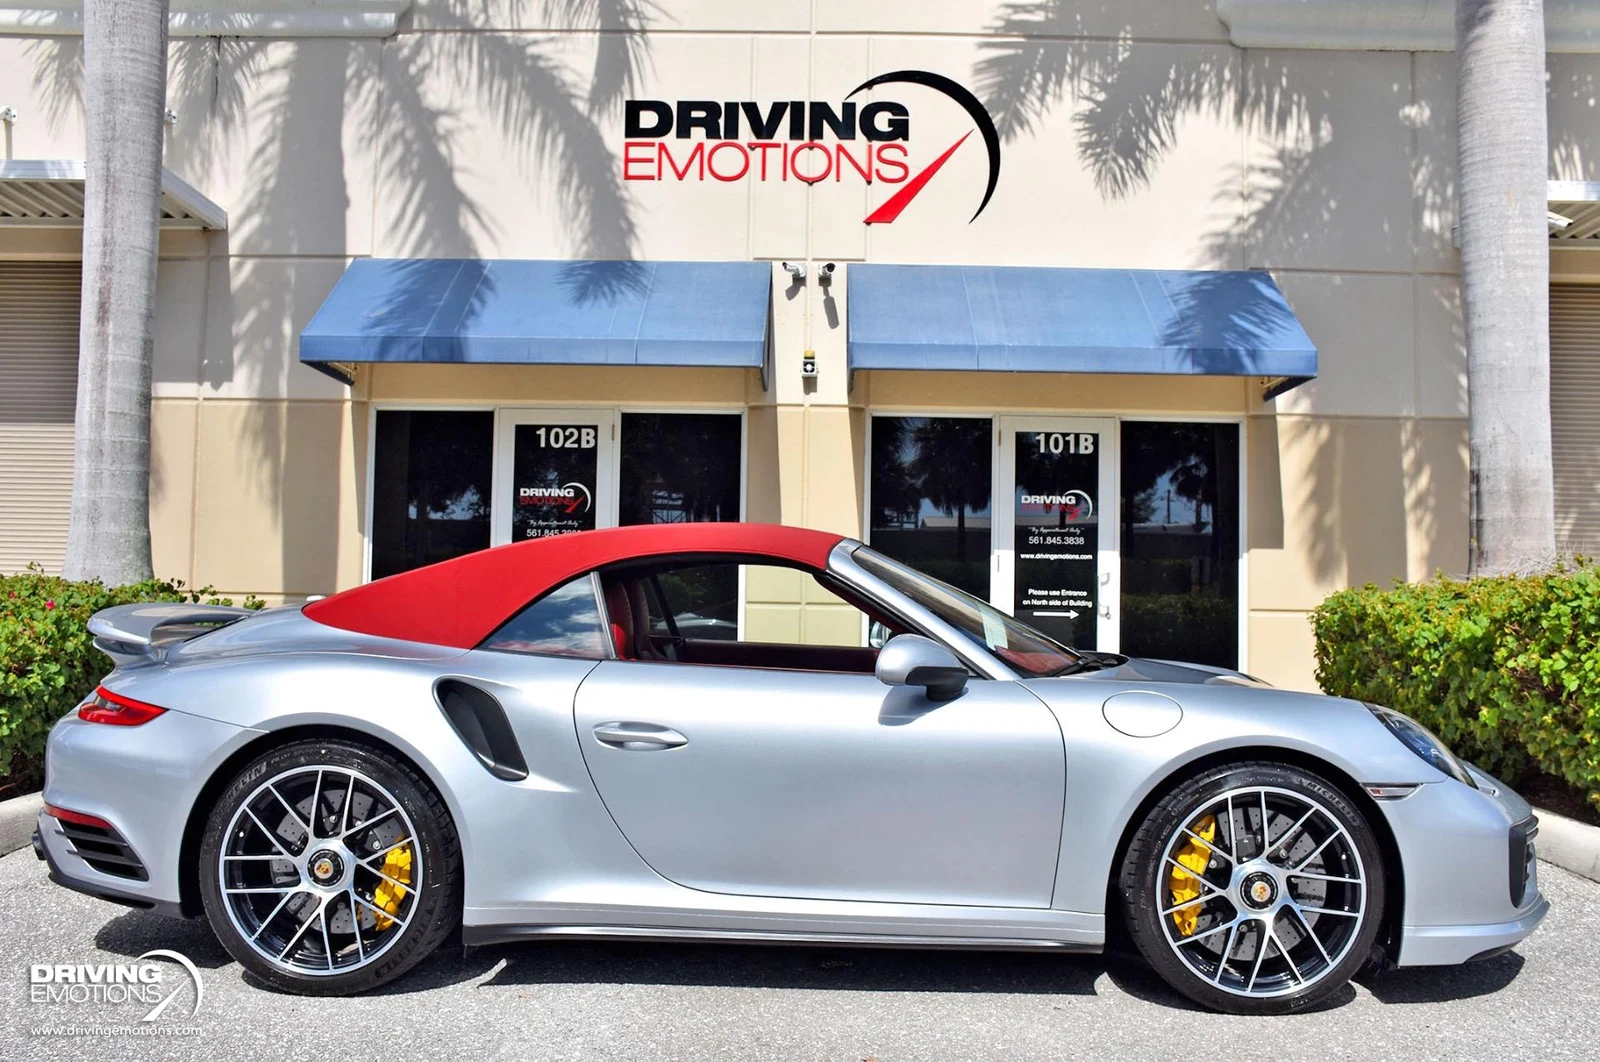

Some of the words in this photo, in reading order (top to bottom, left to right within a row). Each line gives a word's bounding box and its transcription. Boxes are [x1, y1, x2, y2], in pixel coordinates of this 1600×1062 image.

[625, 100, 909, 141] DRIVING
[623, 142, 909, 183] EMOTIONS
[536, 427, 596, 448] 102B
[1036, 433, 1094, 454] 101B
[520, 488, 575, 497] DRIVING
[1021, 495, 1076, 504] DRIVING
[1028, 536, 1085, 545] 561.845.3838
[1020, 553, 1093, 561] www.drivingemotions.com
[1028, 588, 1048, 596] Please
[1061, 589, 1088, 597] Entrance
[1069, 600, 1093, 608] Building
[1306, 780, 1358, 824] MICHELIN
